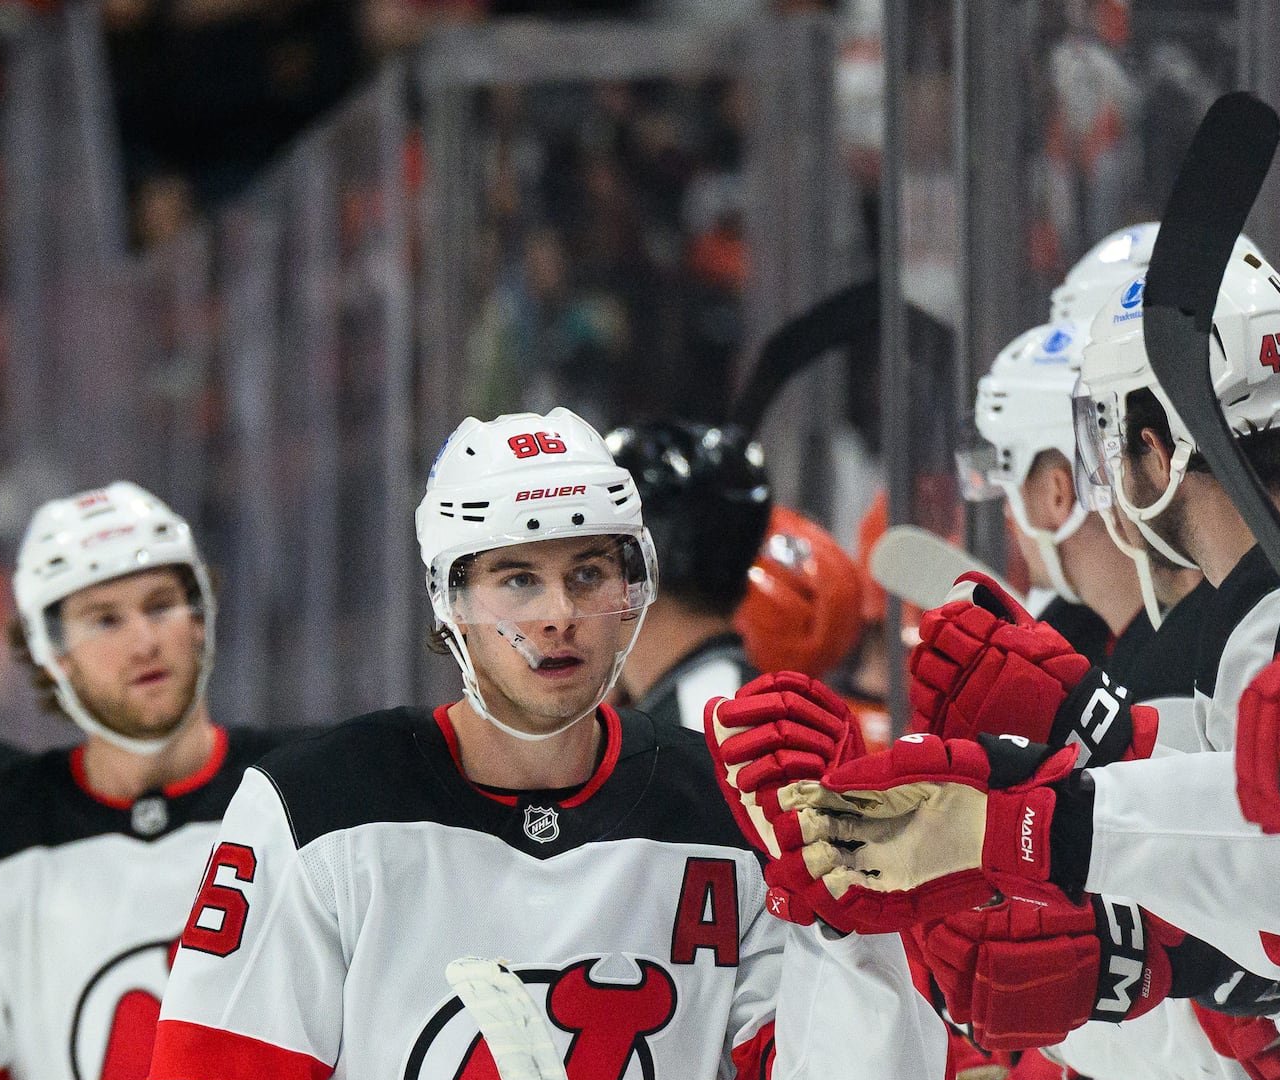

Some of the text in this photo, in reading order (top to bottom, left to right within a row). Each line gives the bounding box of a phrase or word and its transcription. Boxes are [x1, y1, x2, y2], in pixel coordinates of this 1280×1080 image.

[507, 431, 568, 459] 86
[515, 485, 587, 502] BAUER
[531, 817, 552, 834] NHL
[1021, 806, 1036, 863] MACH
[670, 857, 740, 967] A
[1141, 967, 1152, 999] COTTER
